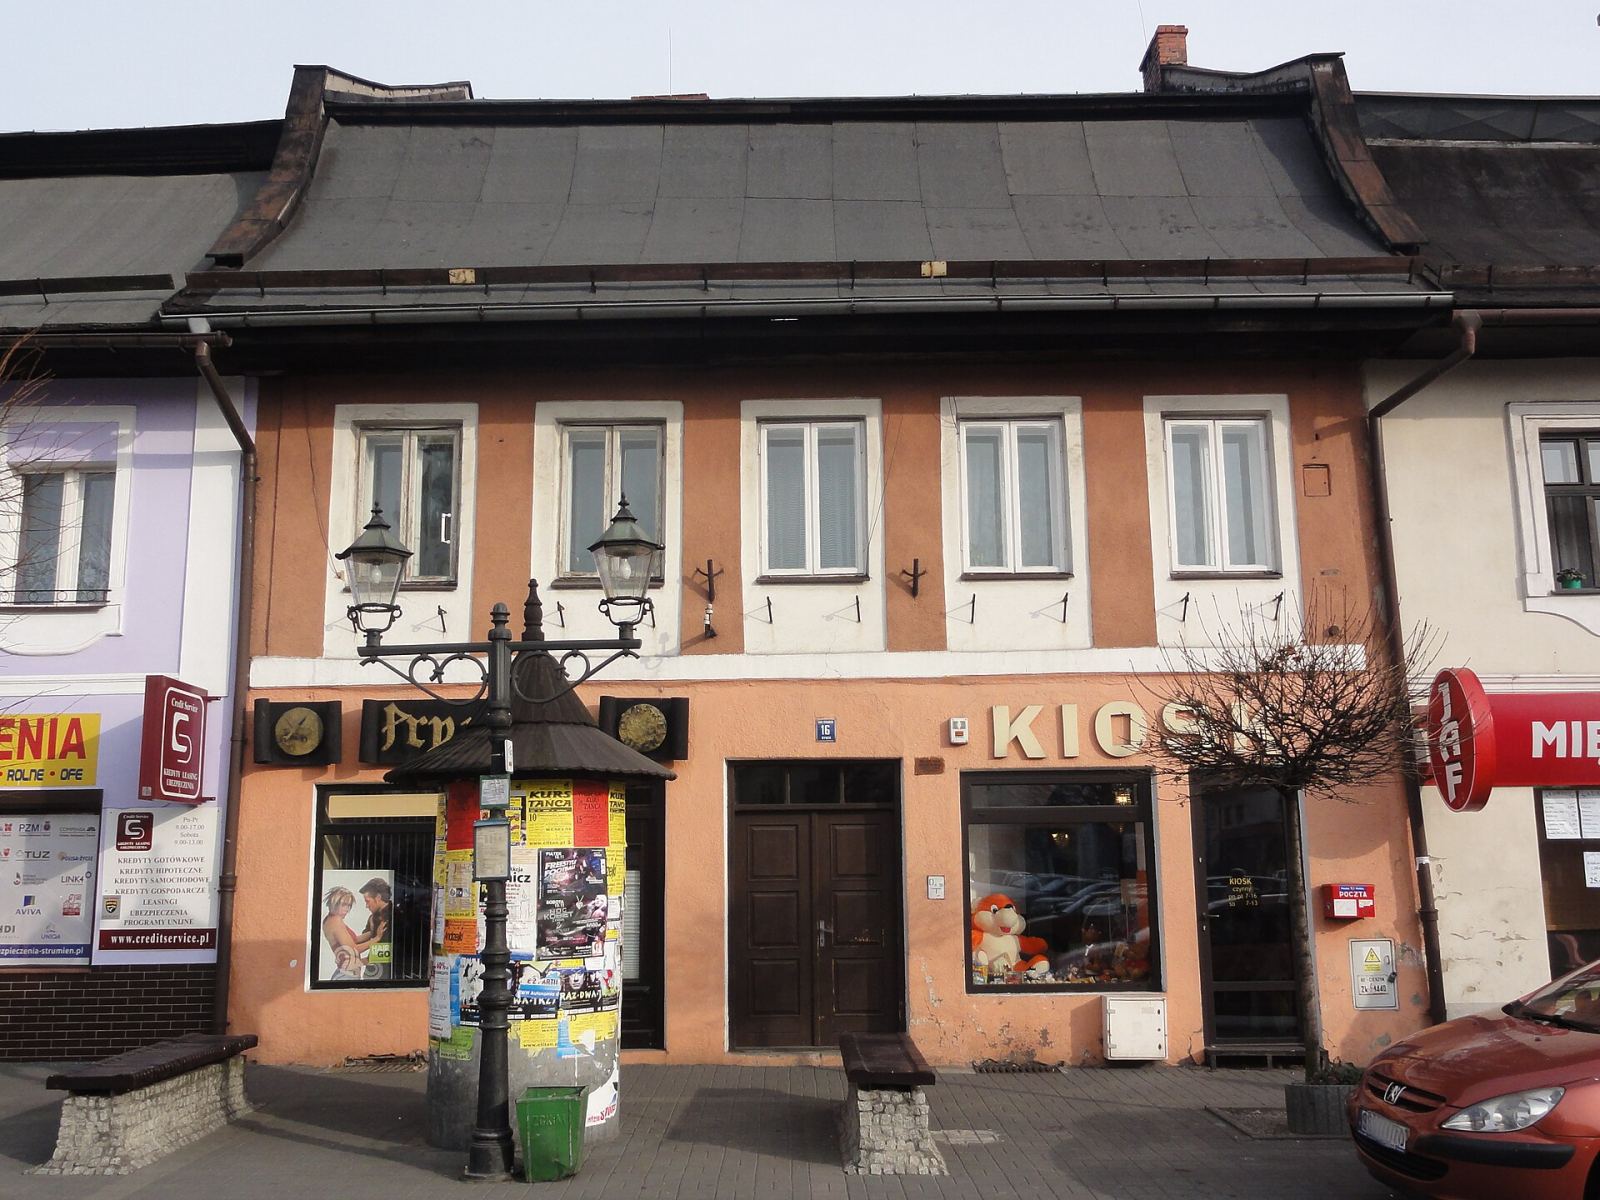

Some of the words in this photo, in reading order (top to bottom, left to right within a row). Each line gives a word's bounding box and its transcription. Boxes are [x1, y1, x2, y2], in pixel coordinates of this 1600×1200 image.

[821, 724, 831, 736] 16
[993, 700, 1284, 759] KIOSK
[0, 717, 87, 760] ENIA
[7, 768, 45, 781] ROLNE
[60, 768, 84, 781] OFE
[529, 790, 572, 799] KURS
[19, 823, 40, 832] PZM
[24, 850, 51, 859] TUZ
[153, 855, 205, 863] GOTÓWKOWE
[119, 867, 154, 875] KREDYTY
[155, 866, 203, 874] HIPOTECZNE
[61, 875, 84, 883] LINK4
[150, 876, 209, 884] SAMOCHODOWE
[1229, 877, 1252, 885] KIOSK
[1338, 890, 1368, 898] POCZTA
[110, 932, 210, 946] www.creditservice.pl
[377, 950, 390, 958] GO
